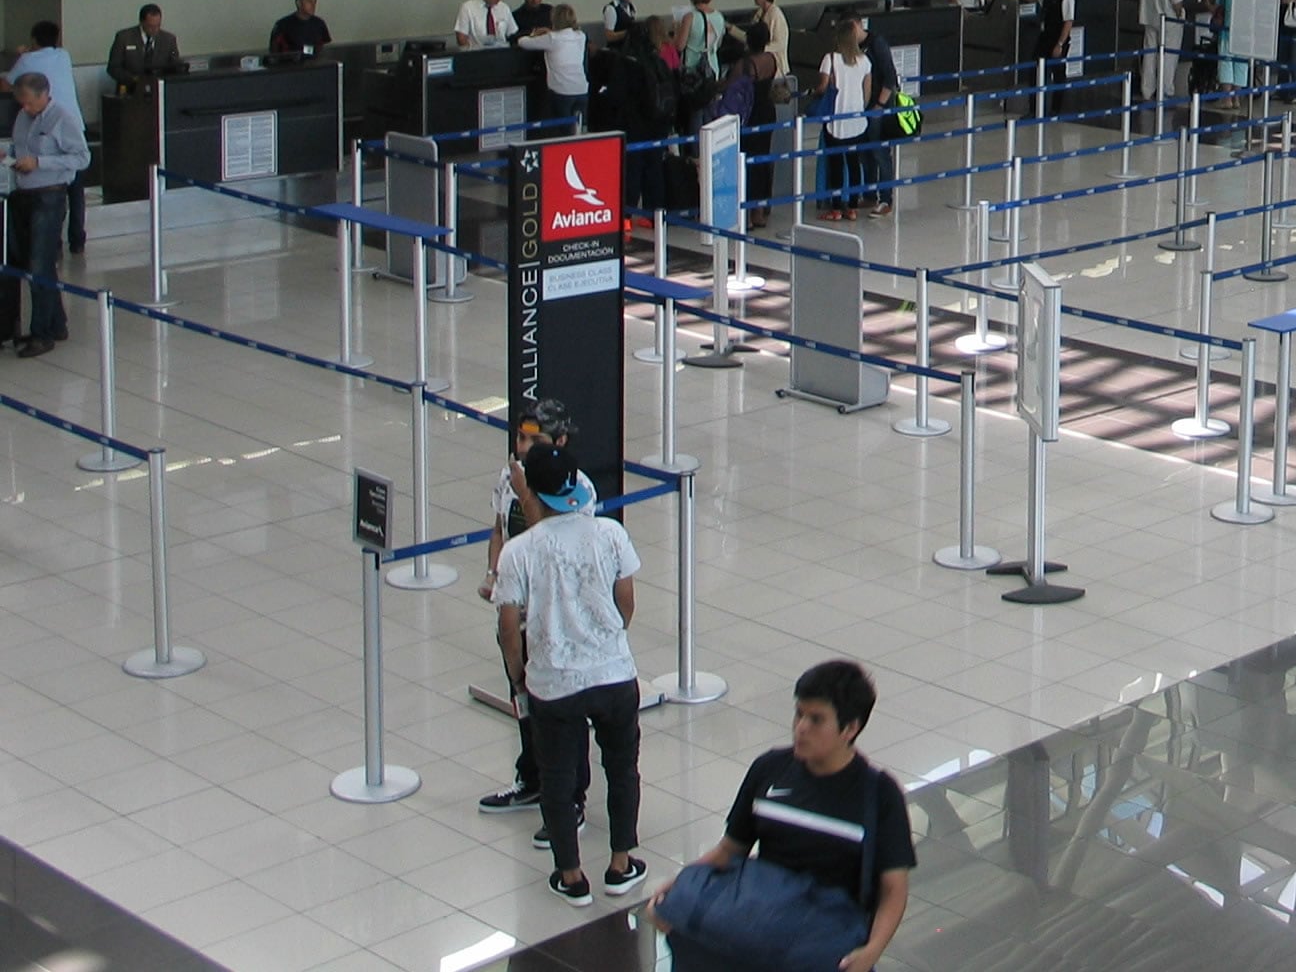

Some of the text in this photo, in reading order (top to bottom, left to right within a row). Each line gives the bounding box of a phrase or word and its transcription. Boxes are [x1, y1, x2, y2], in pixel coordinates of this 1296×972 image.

[522, 182, 539, 259] GOLD
[551, 208, 612, 230] Avianca
[562, 240, 600, 252] CHECK-IN
[522, 268, 539, 401] ALLIANCE
